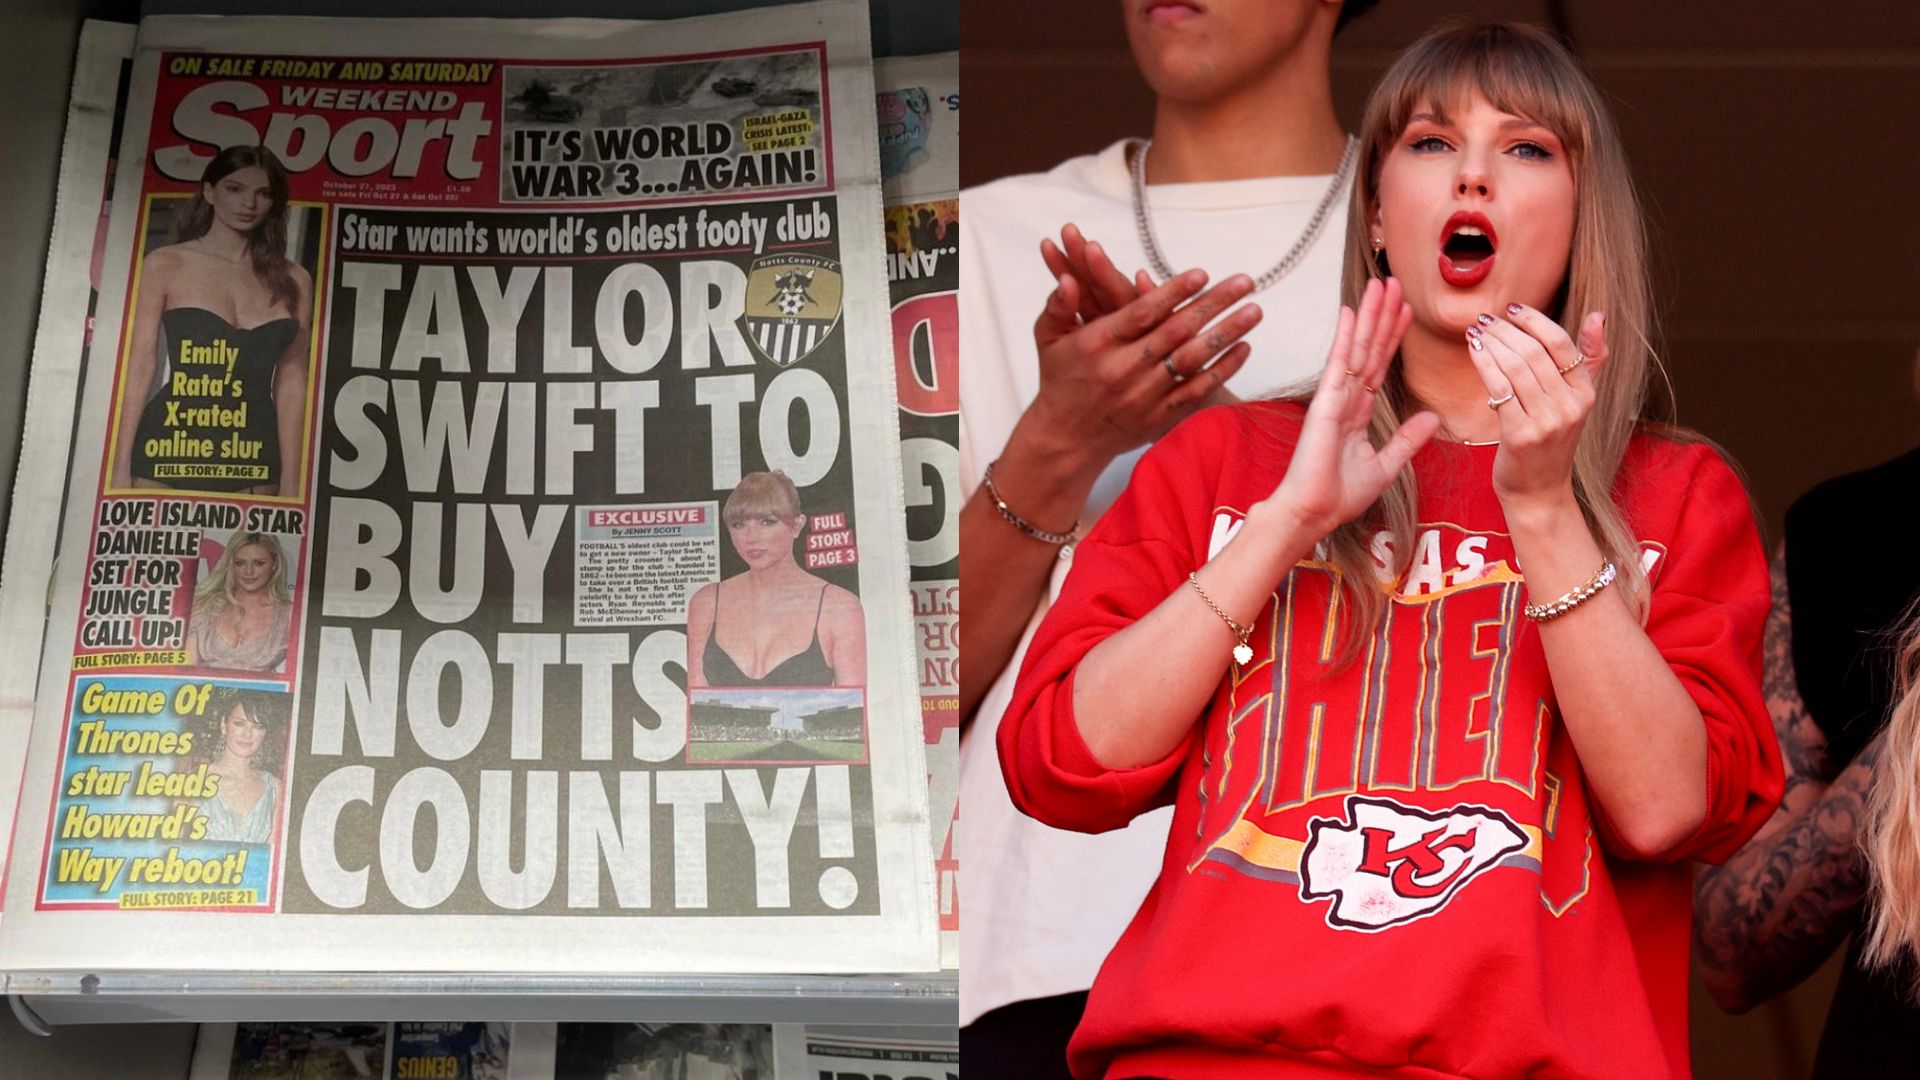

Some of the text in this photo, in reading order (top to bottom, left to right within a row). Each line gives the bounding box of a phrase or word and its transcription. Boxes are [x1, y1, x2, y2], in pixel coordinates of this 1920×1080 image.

[170, 57, 494, 83] ON SALE FRIDAY AND SATURDAY
[281, 86, 458, 111] WEEKEND
[154, 80, 492, 181] Sport
[744, 123, 811, 140] CRISIS LATEST:
[746, 111, 807, 127] ISRAEL-GAZA
[513, 123, 732, 162] IT'S WORLD
[752, 136, 806, 152] SEE PAGE 2
[513, 164, 602, 198] WAR
[342, 202, 831, 255] Star wants world's oldest footy club
[759, 257, 835, 270] Notts County FC
[341, 260, 756, 375] TAYLOR
[180, 339, 240, 374] Emily
[172, 372, 243, 397] Rata's
[164, 403, 247, 429] X-rated
[329, 368, 841, 496] SWIFT TO
[144, 432, 263, 460] online slur
[157, 465, 266, 478] FULL STORY: PAGE 7
[101, 501, 304, 535] LOVE ISLAND STAR
[593, 509, 699, 526] EXCLUSIVE
[814, 514, 843, 530] FULL
[96, 531, 199, 556] DANIELLE
[612, 526, 682, 536] By JENNY SCOTT
[810, 531, 850, 549] STORY
[322, 496, 569, 625] BUY
[809, 549, 855, 567] PAGE 3
[91, 560, 181, 585] SET FOR
[86, 590, 171, 615] JUNGLE
[625, 593, 638, 601] buy
[83, 620, 182, 646] CALL UP!
[74, 652, 185, 668] FULL STORY: PAGE 5
[81, 682, 214, 715] Game Of
[310, 626, 688, 763] NOTTS
[77, 721, 194, 755] Thrones
[67, 761, 220, 798] star leads
[61, 804, 208, 841] Howard's
[300, 764, 859, 910] COUNTY!
[57, 847, 248, 892] Way reboot!
[123, 892, 253, 907] FULL STORY: PAGE 21
[397, 1056, 458, 1078] GENIUS
